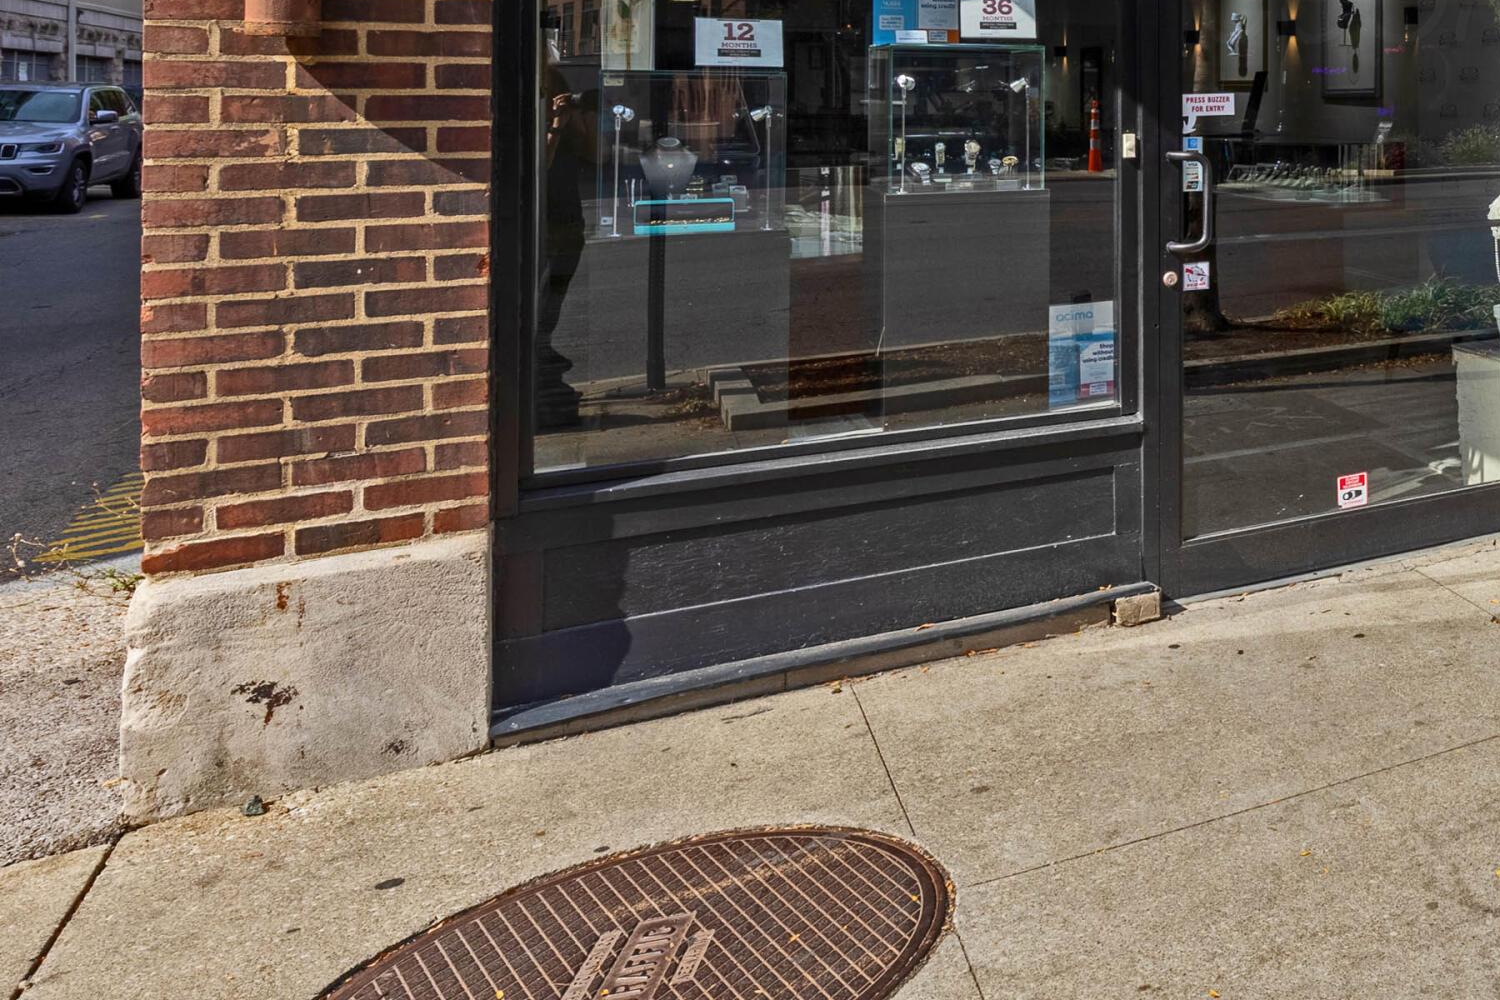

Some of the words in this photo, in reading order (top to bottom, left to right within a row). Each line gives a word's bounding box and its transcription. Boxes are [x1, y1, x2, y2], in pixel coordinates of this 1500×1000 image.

[723, 22, 755, 41] 12
[1056, 310, 1094, 322] acima
[602, 925, 676, 999] RAFFIC
